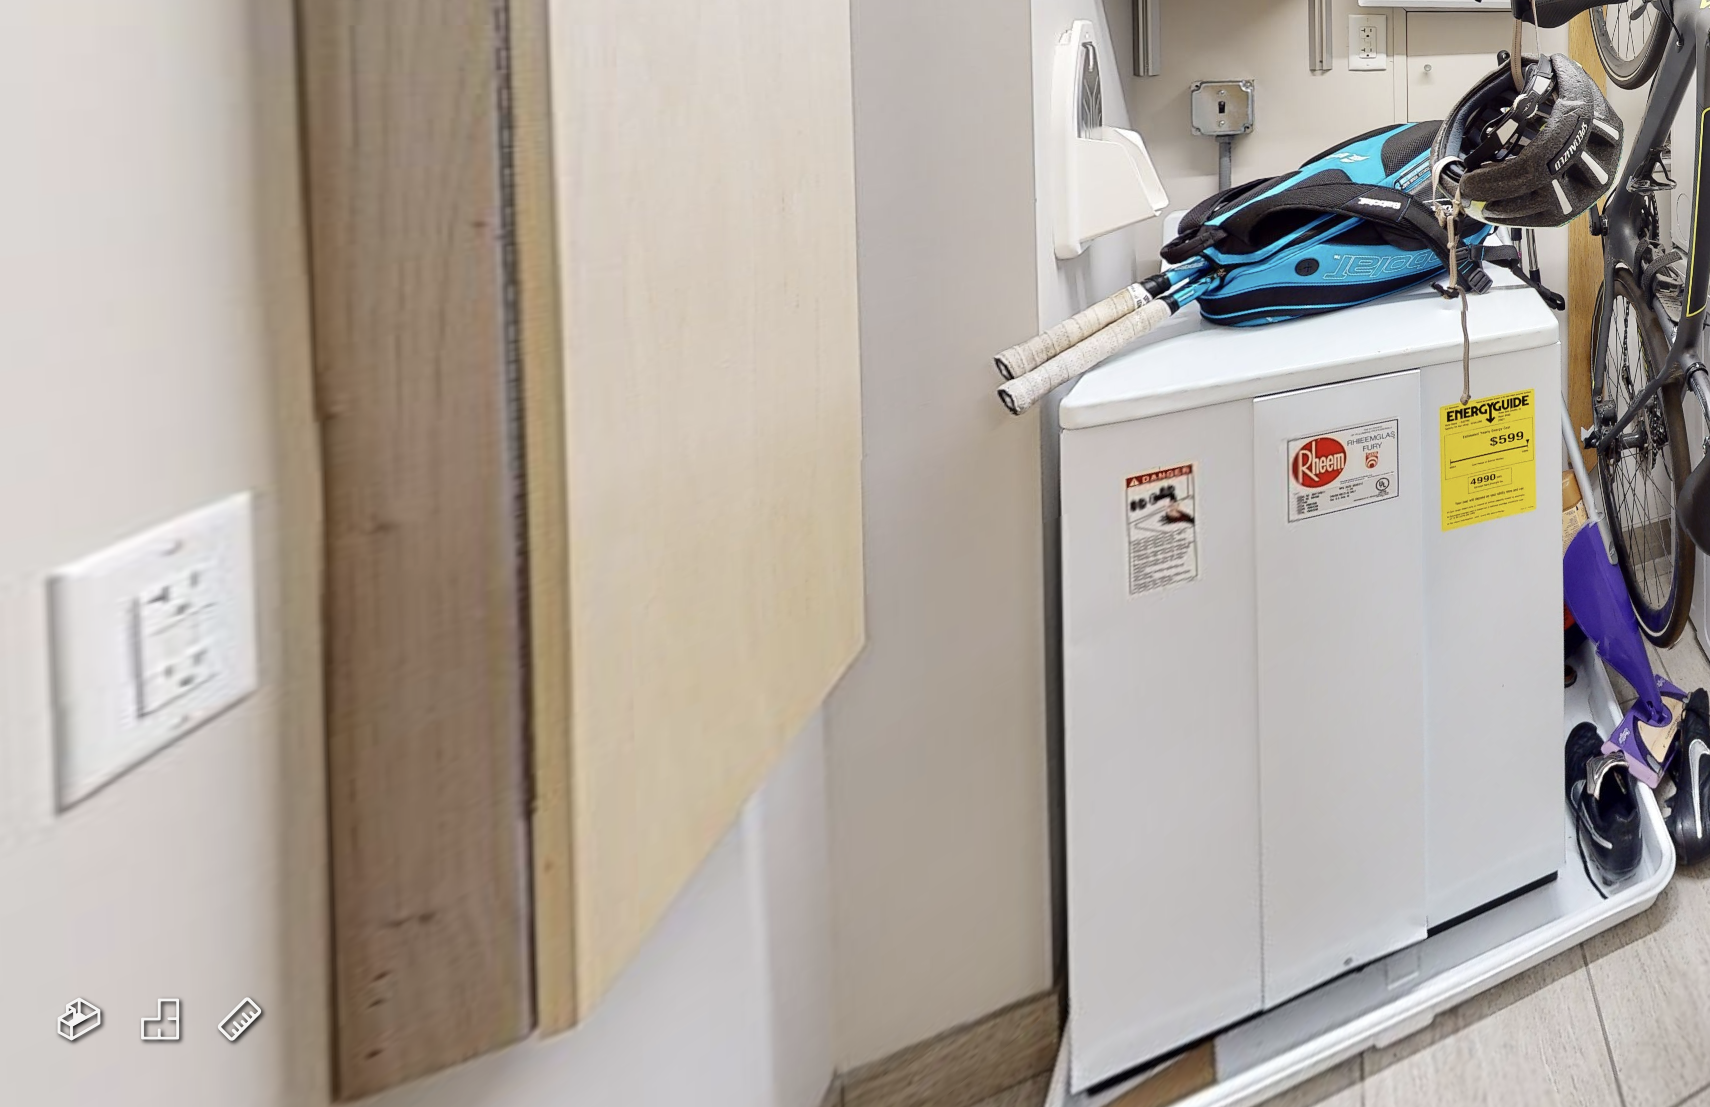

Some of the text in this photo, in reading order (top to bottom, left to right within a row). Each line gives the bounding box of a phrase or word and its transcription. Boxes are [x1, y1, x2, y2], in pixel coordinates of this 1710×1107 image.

[1554, 121, 1588, 172] SPECIALIZED
[1446, 394, 1530, 423] ENERGYGUIDE
[1362, 442, 1382, 452] FURY
[1489, 430, 1524, 447] $599
[1297, 440, 1345, 485] Rheem
[1470, 473, 1496, 485] 4990
